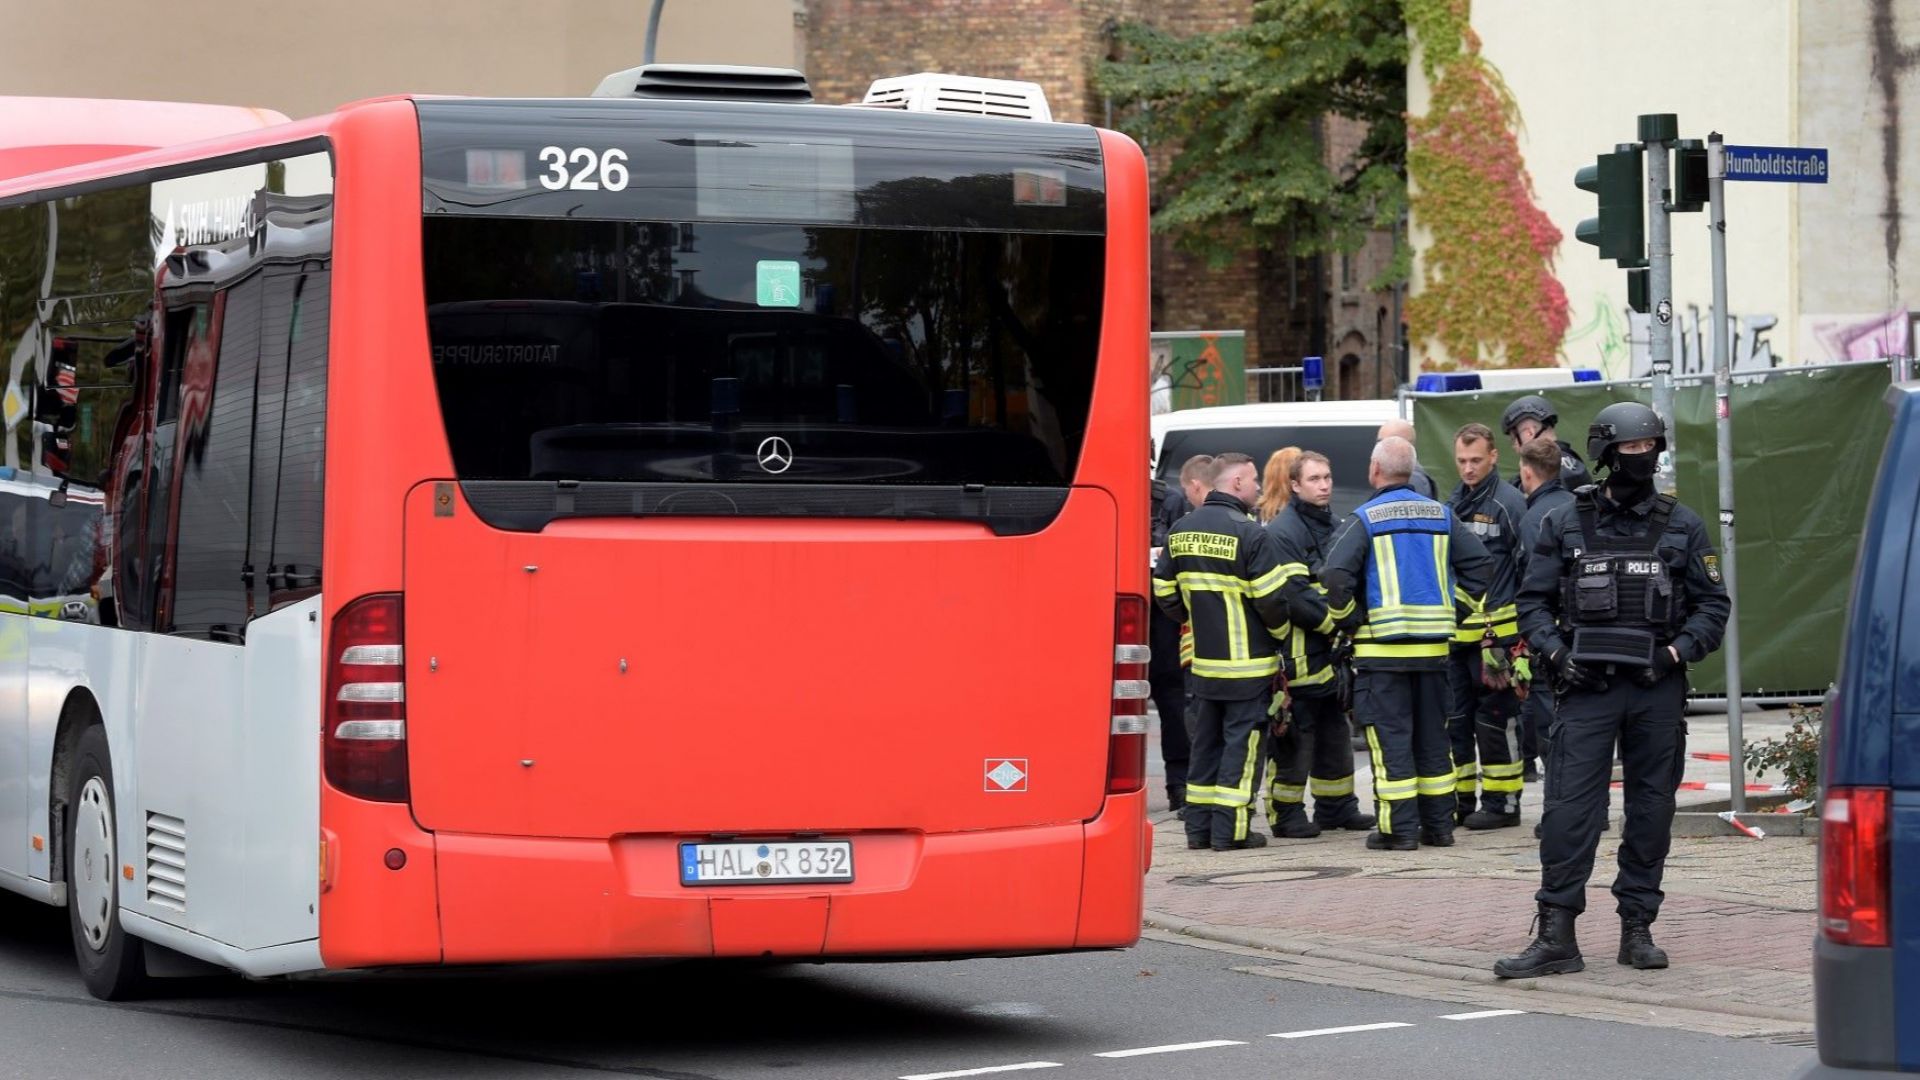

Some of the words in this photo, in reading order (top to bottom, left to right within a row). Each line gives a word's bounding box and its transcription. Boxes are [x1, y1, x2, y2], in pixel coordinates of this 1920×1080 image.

[538, 145, 629, 191] 326
[1725, 152, 1825, 176] Humboldtstraße
[1170, 533, 1235, 547] FEUERWEHR
[1198, 544, 1234, 557] (Saale)
[700, 848, 753, 876] HAL
[775, 848, 791, 875] R
[799, 847, 848, 875] 832
